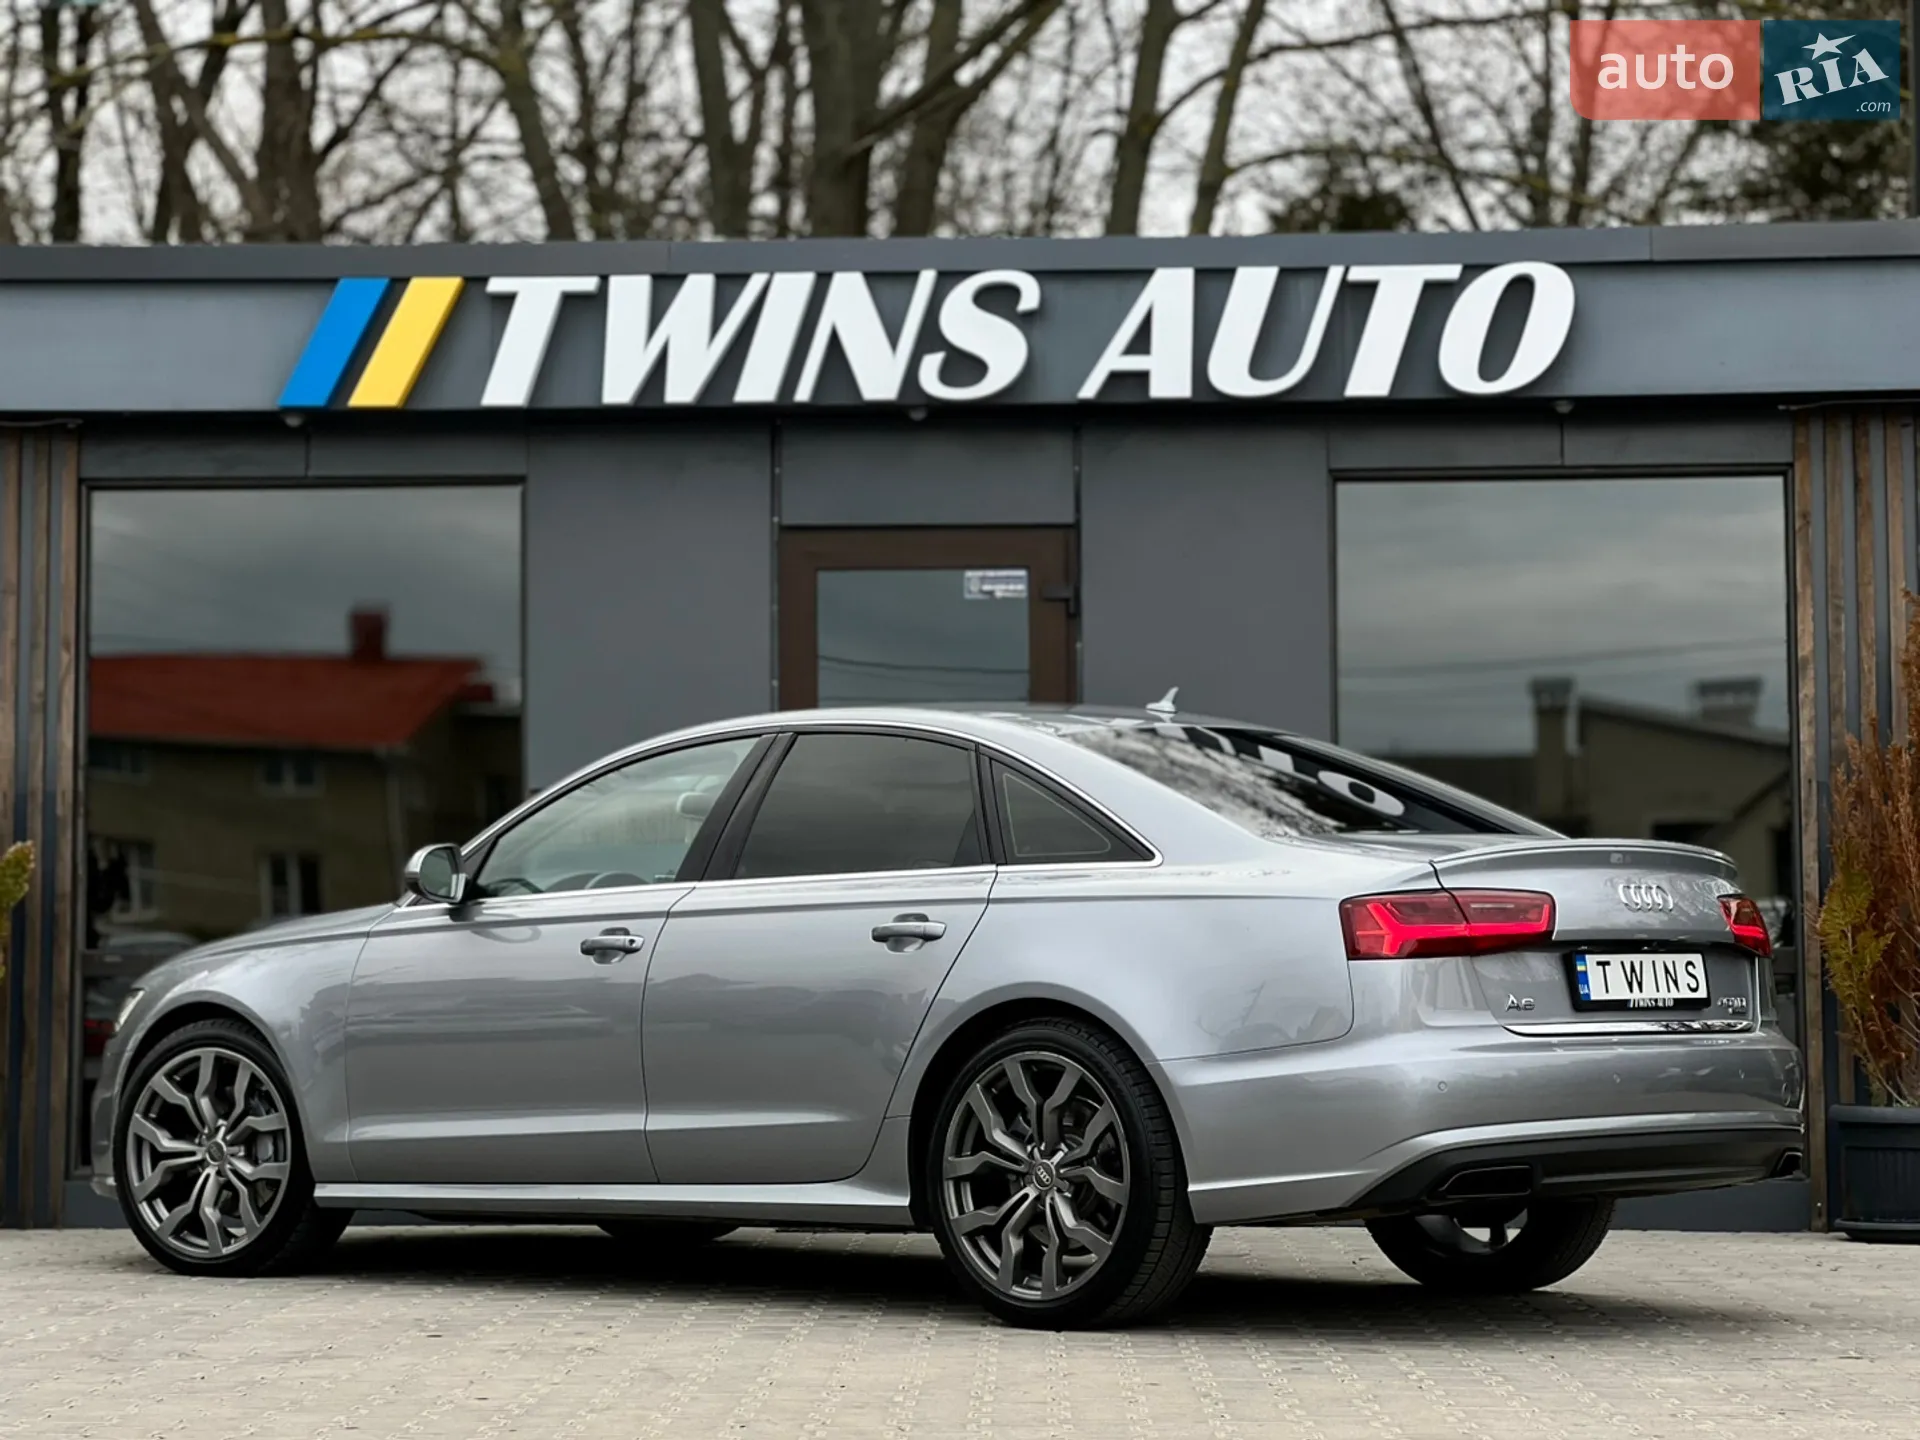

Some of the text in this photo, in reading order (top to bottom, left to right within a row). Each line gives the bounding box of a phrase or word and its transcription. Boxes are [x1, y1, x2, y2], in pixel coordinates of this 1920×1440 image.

[481, 260, 1576, 407] TWINS AUTO
[1596, 960, 1700, 994] TWINS
[1505, 993, 1535, 1011] A6
